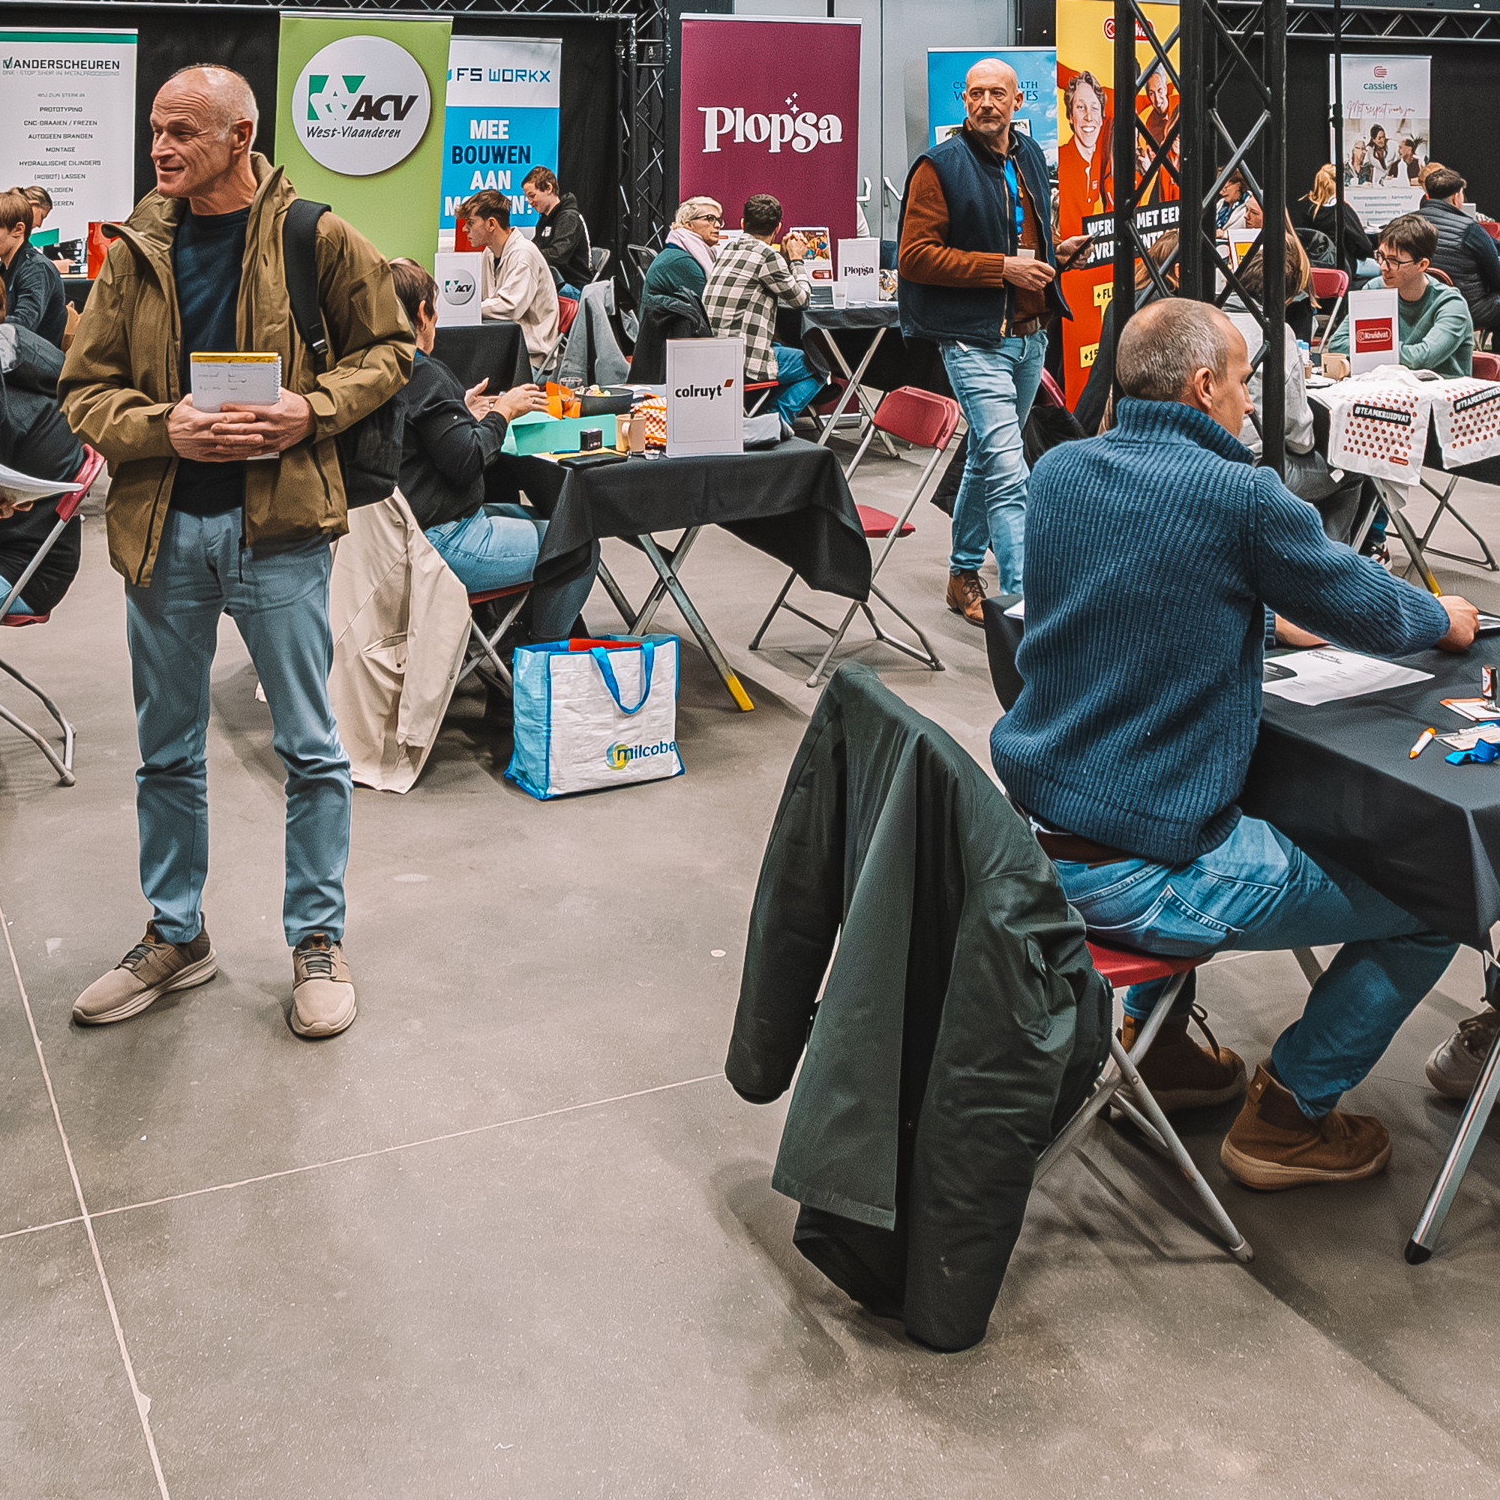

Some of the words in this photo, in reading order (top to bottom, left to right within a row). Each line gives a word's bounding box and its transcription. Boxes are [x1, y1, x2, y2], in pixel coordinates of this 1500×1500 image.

[3, 57, 120, 70] VANDERSCHEUREN
[488, 68, 551, 83] WORKX
[1363, 81, 1398, 91] cassiers
[347, 94, 419, 121] ACV
[306, 126, 402, 138] West-Vlaanderen
[469, 119, 510, 140] MEE
[697, 106, 843, 153] Plopsa
[451, 145, 531, 165] BOUWEN
[469, 170, 511, 190] AAN
[1136, 210, 1159, 229] MET
[843, 265, 875, 277] Plopsa
[455, 283, 473, 293] ACV
[675, 384, 723, 400] colruyt
[1354, 406, 1410, 423] #TEAMKRUIDVAT
[616, 740, 676, 762] milcobe
